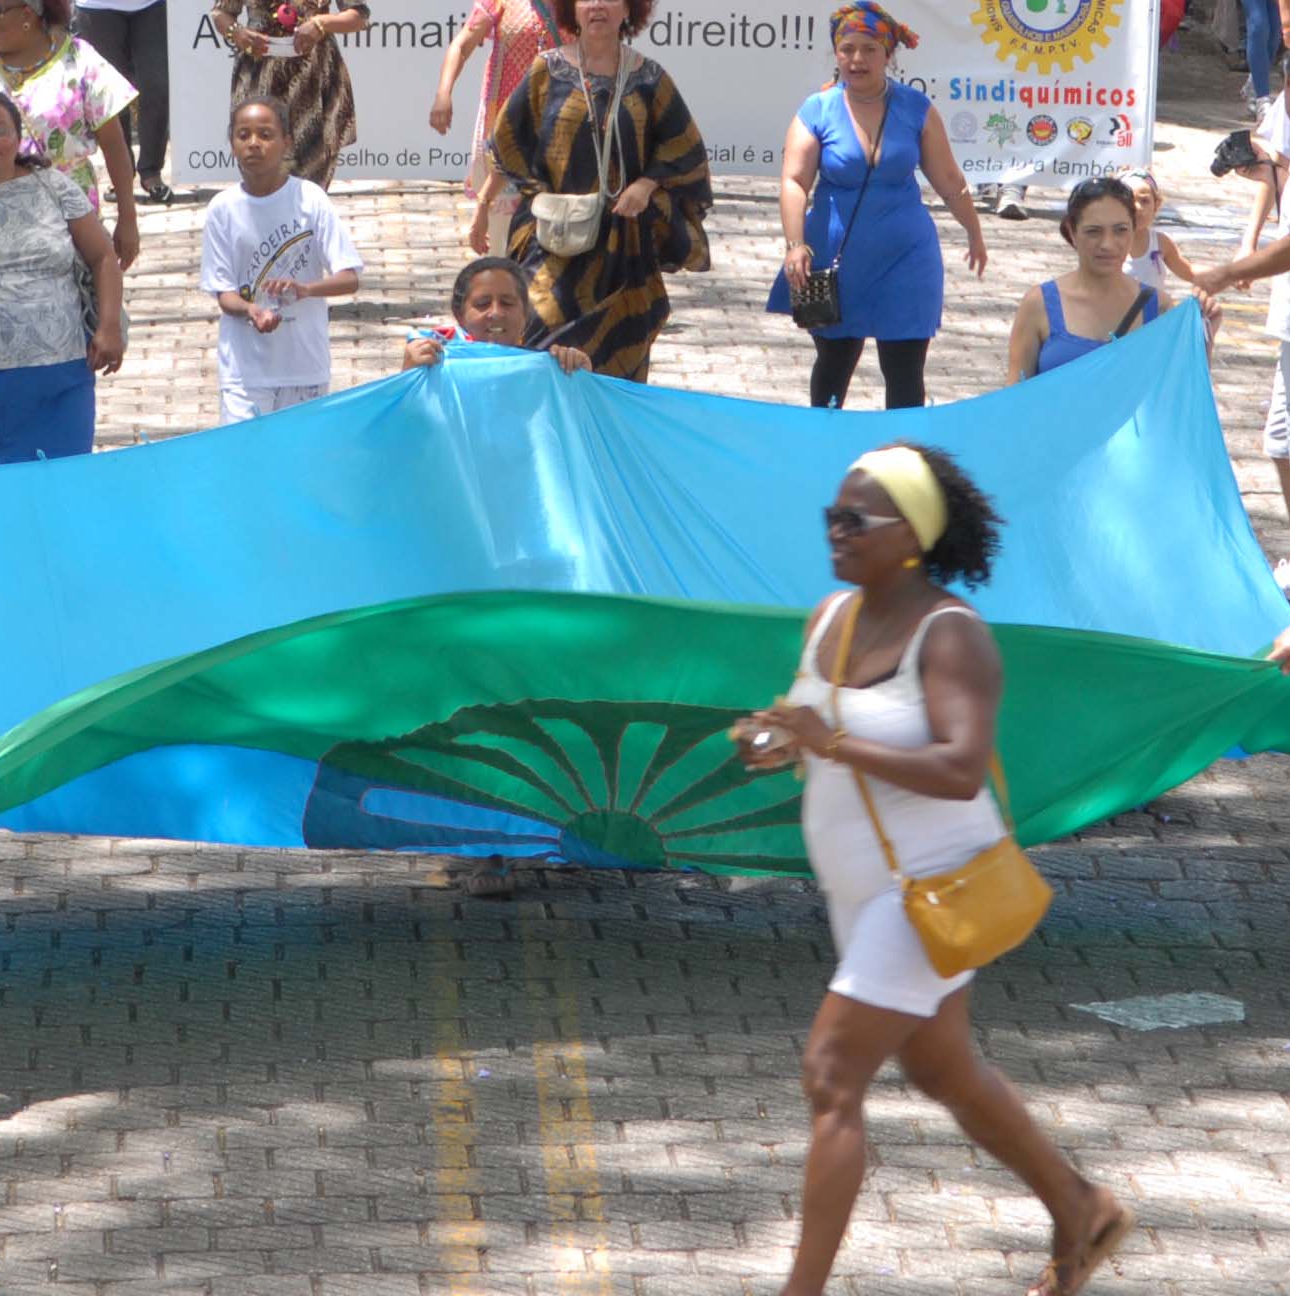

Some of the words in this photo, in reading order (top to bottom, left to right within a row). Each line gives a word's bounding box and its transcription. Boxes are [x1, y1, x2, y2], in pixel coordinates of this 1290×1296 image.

[650, 12, 815, 50] direito!!!
[949, 77, 1136, 108] Sindiquímicos
[336, 148, 390, 167] selho
[395, 148, 421, 167] de
[707, 144, 736, 163] cial
[743, 144, 755, 163] é
[762, 151, 774, 163] a
[962, 156, 1004, 172] esta
[245, 218, 302, 284] CAPOEIRA
